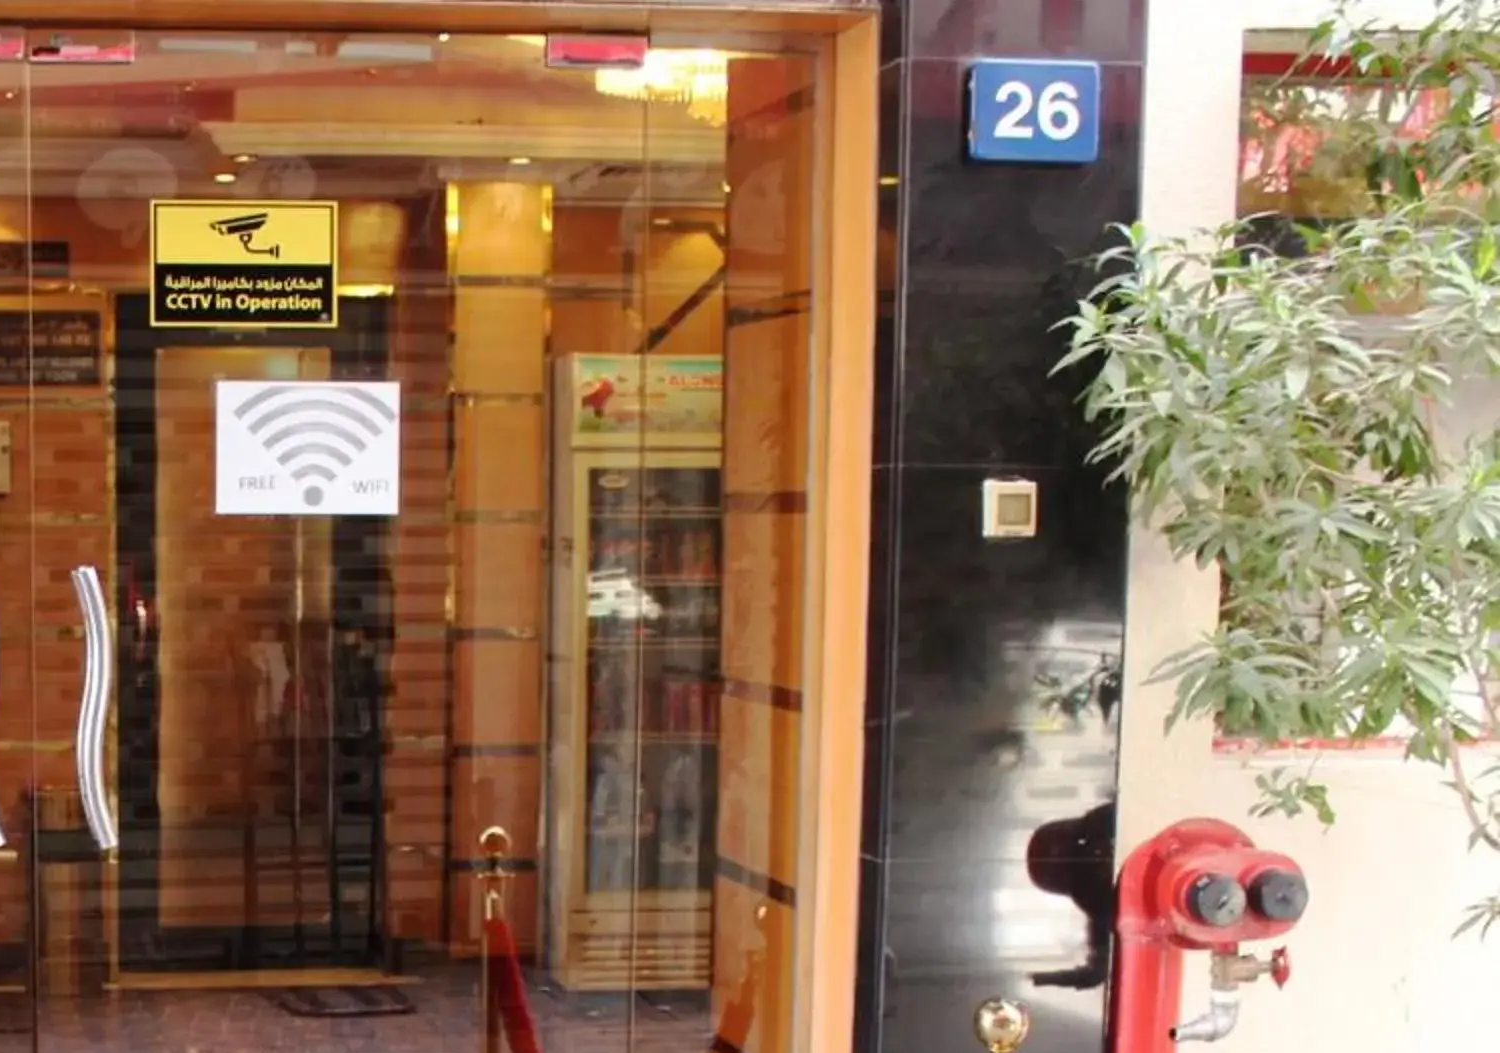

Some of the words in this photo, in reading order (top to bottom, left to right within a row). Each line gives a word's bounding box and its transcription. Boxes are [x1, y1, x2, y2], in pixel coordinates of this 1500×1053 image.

[993, 80, 1080, 141] 26
[165, 294, 212, 310] CCTV
[215, 294, 232, 309] in
[235, 293, 322, 313] Operation
[238, 475, 276, 491] FREE
